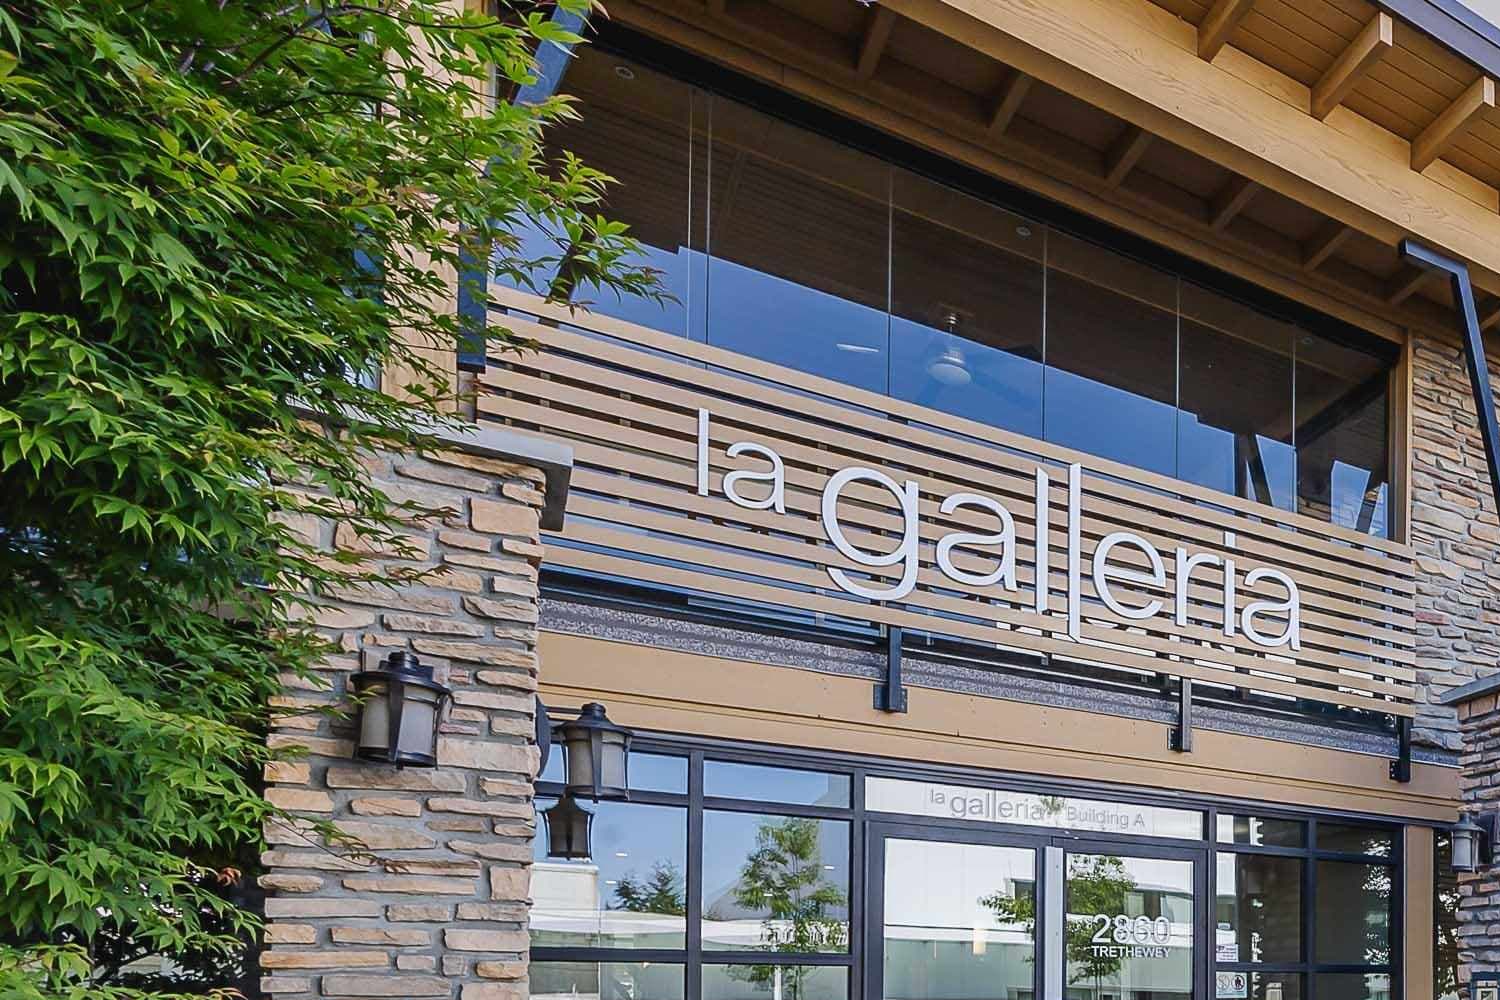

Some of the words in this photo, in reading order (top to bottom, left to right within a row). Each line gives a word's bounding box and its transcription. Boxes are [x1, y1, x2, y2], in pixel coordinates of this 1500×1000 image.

[697, 407, 787, 515] la
[821, 462, 1302, 652] galleria
[930, 789, 946, 804] la
[950, 789, 1046, 820] galleria
[1066, 806, 1129, 829] Building
[1133, 813, 1146, 828] A
[1092, 914, 1171, 944] 2860
[1091, 945, 1171, 959] TRETHEWEY
